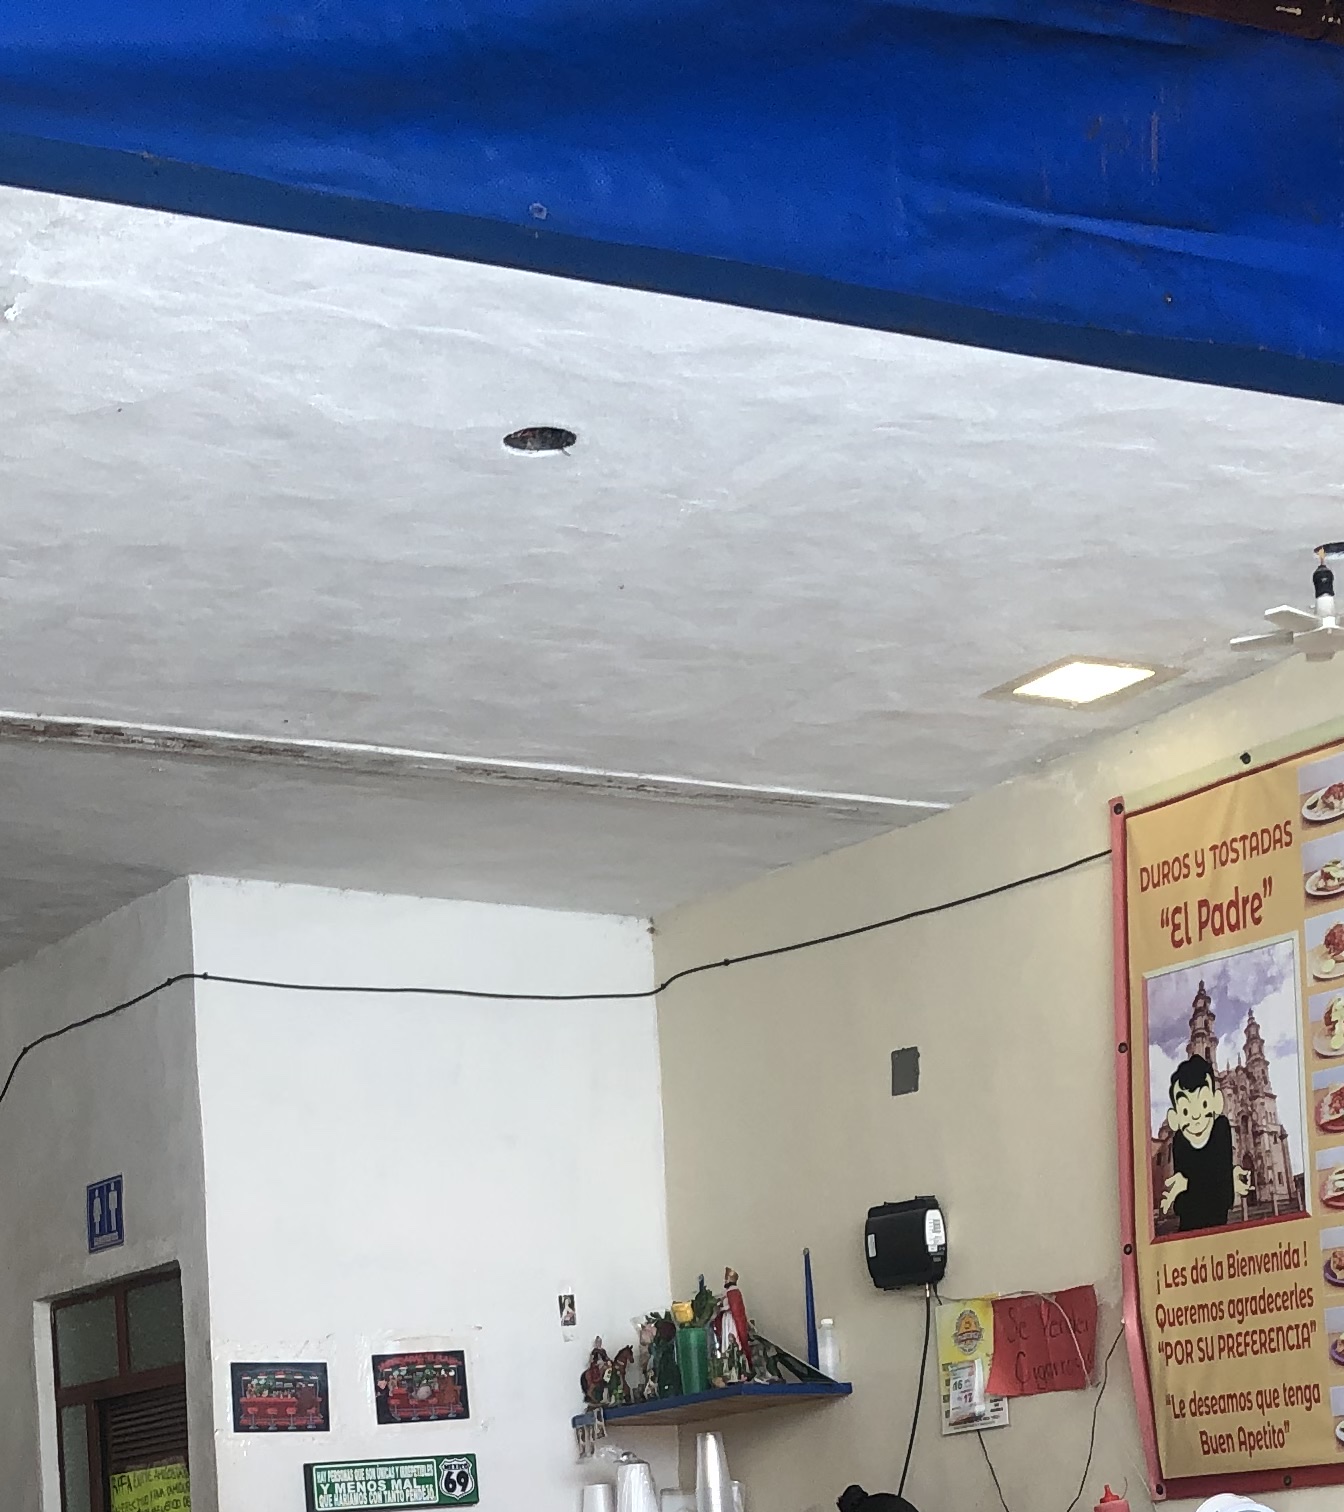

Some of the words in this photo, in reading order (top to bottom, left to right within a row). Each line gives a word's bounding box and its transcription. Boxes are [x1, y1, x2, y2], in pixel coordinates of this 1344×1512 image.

[1140, 853, 1190, 892] DUROS
[1209, 820, 1292, 870] TOSTADAS
[1163, 1264, 1187, 1288] Les
[1191, 1256, 1207, 1284] dá
[1211, 1255, 1223, 1281] la
[1227, 1242, 1300, 1279] Bienvenida
[1156, 1301, 1224, 1334] Queremos
[1228, 1282, 1314, 1324] agradecerles
[1197, 1336, 1214, 1362] SU
[1189, 1391, 1253, 1417] deseamos
[1256, 1388, 1280, 1416] que
[1283, 1383, 1320, 1411] tenga
[1199, 1430, 1235, 1455] Buen
[320, 1483, 330, 1494] Y
[335, 1480, 387, 1493] MENOS
[444, 1470, 469, 1493] 69
